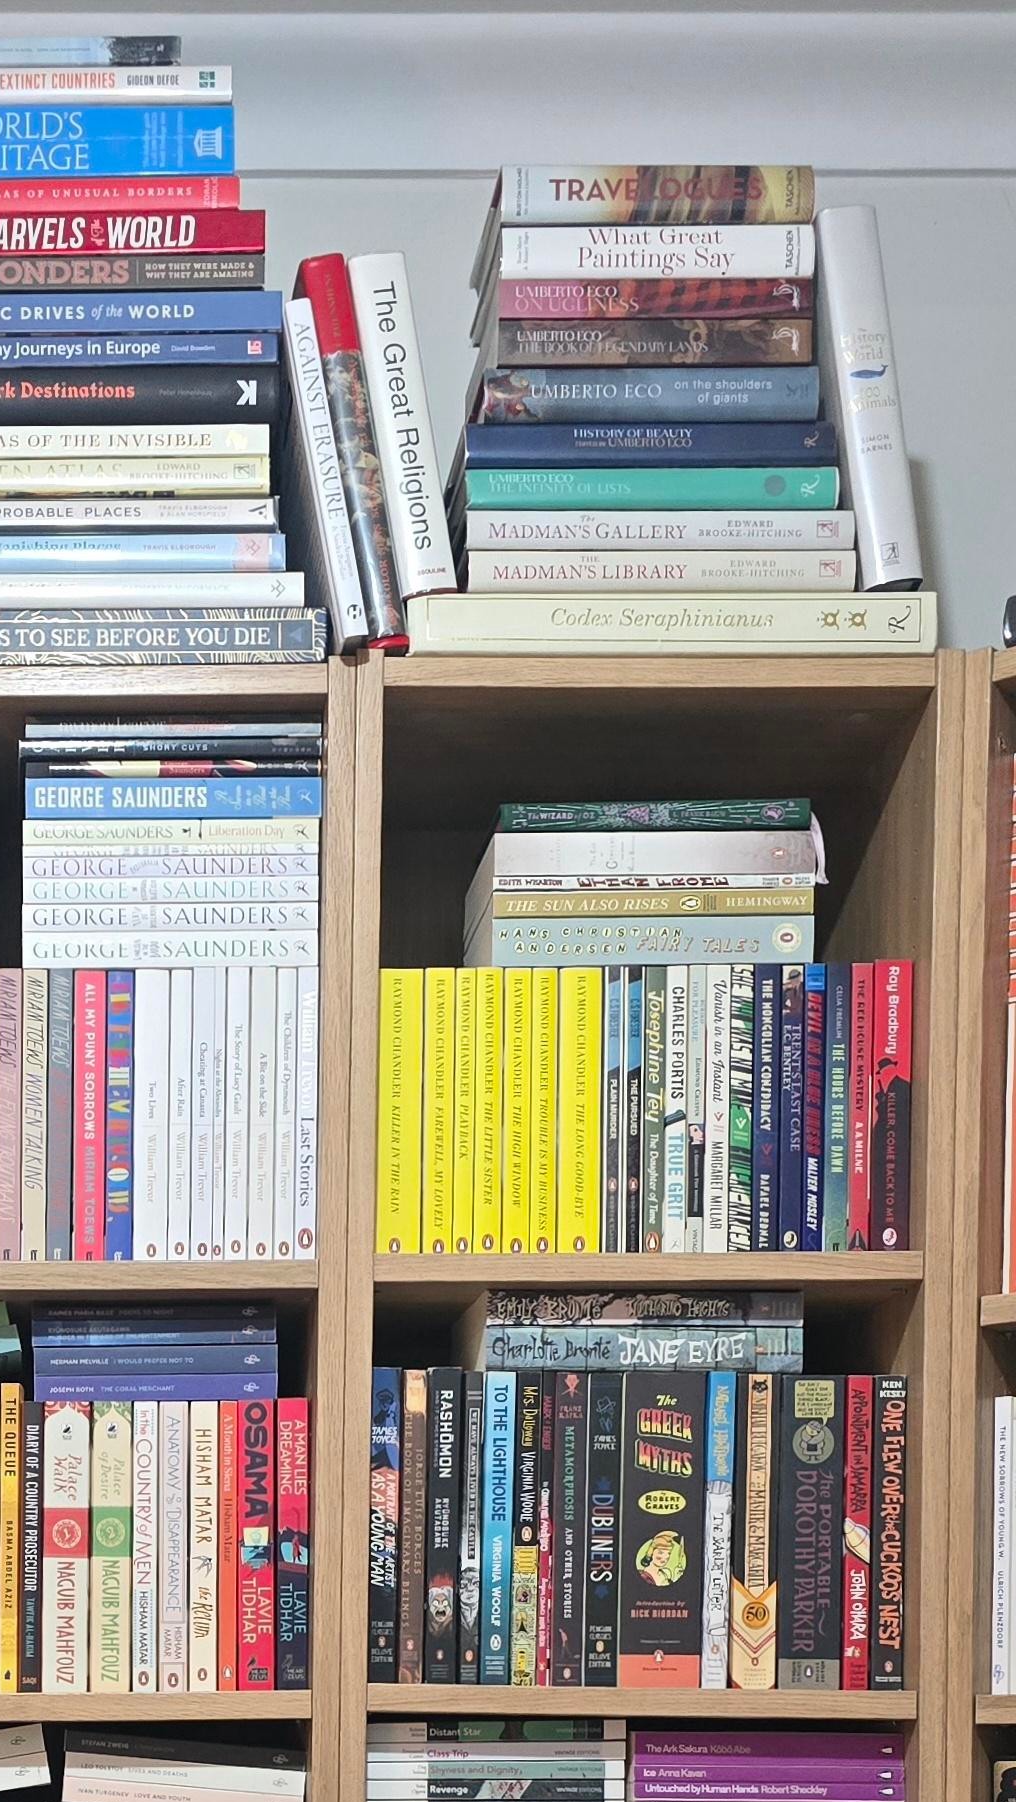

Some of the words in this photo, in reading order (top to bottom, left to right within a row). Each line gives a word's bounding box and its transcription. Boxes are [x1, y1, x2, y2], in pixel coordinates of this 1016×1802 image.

[106, 214, 197, 249] WORLD
[589, 228, 649, 246] What
[659, 228, 722, 246] Great
[577, 248, 685, 275] Paintings
[694, 249, 735, 276] Say
[374, 281, 397, 333] The
[15, 342, 85, 361] Journeys
[88, 342, 101, 357] in
[104, 341, 161, 361] Europe
[20, 381, 135, 399] Destinations
[383, 347, 414, 420] Great
[396, 429, 431, 549] Religions
[15, 628, 45, 646] TO
[51, 628, 89, 646] SEE
[96, 627, 179, 646] BEFORE
[185, 627, 229, 645] YOU
[235, 627, 271, 645] DIE
[551, 607, 614, 628] Codex
[619, 608, 775, 631] Seraphinianus
[34, 787, 103, 808] GEORGE
[112, 786, 207, 808] SAUNDERS
[887, 966, 899, 987] Ray
[672, 987, 684, 1047] CHARLES
[884, 994, 900, 1054] Bradbury
[647, 990, 665, 1084] Josephine
[671, 1052, 684, 1099] PORTIS
[646, 1088, 664, 1121] Tey
[668, 1134, 683, 1171] TRUE
[668, 1175, 683, 1219] GRIT
[617, 1333, 687, 1365] JANE
[688, 1333, 745, 1360] EYRE
[494, 1386, 508, 1403] TO
[493, 1408, 508, 1433] THE
[638, 1409, 692, 1441] GREEK
[243, 1403, 267, 1517] OSAMA
[635, 1439, 692, 1477] MYTHS
[492, 1440, 507, 1521] LIGHTHOUSE
[492, 1534, 503, 1580] VIRGINIA
[591, 1494, 614, 1583] DUBLINERS
[58, 1561, 75, 1609] NAGUIB
[492, 1585, 503, 1625] WOOLF
[57, 1616, 75, 1684] MAHFOUZ
